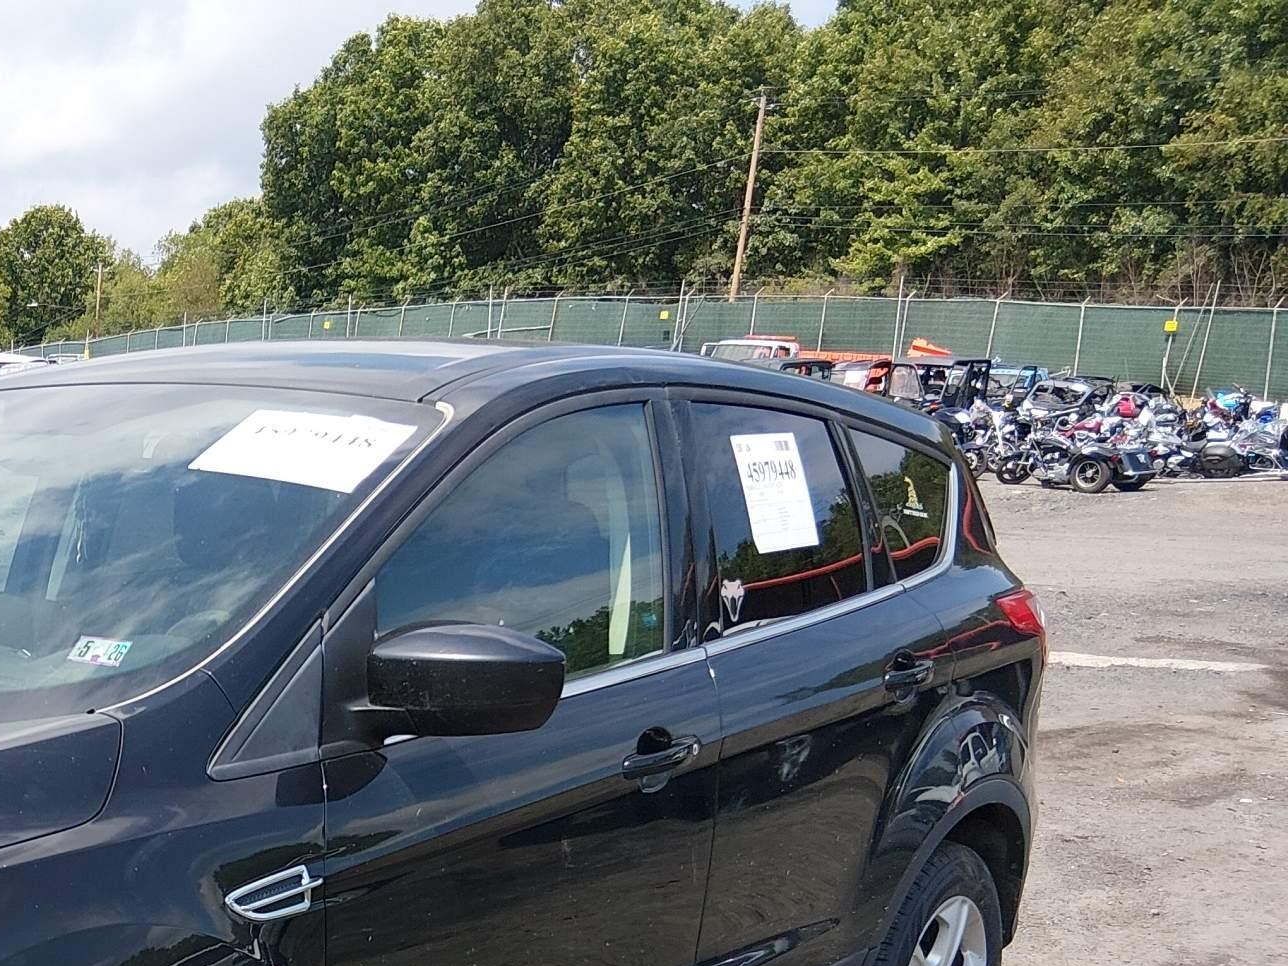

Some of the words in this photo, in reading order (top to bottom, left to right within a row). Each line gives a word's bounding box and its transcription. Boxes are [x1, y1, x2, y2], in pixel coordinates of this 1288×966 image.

[747, 459, 797, 482] 45979448
[78, 640, 95, 657] 5
[108, 643, 128, 662] 26
